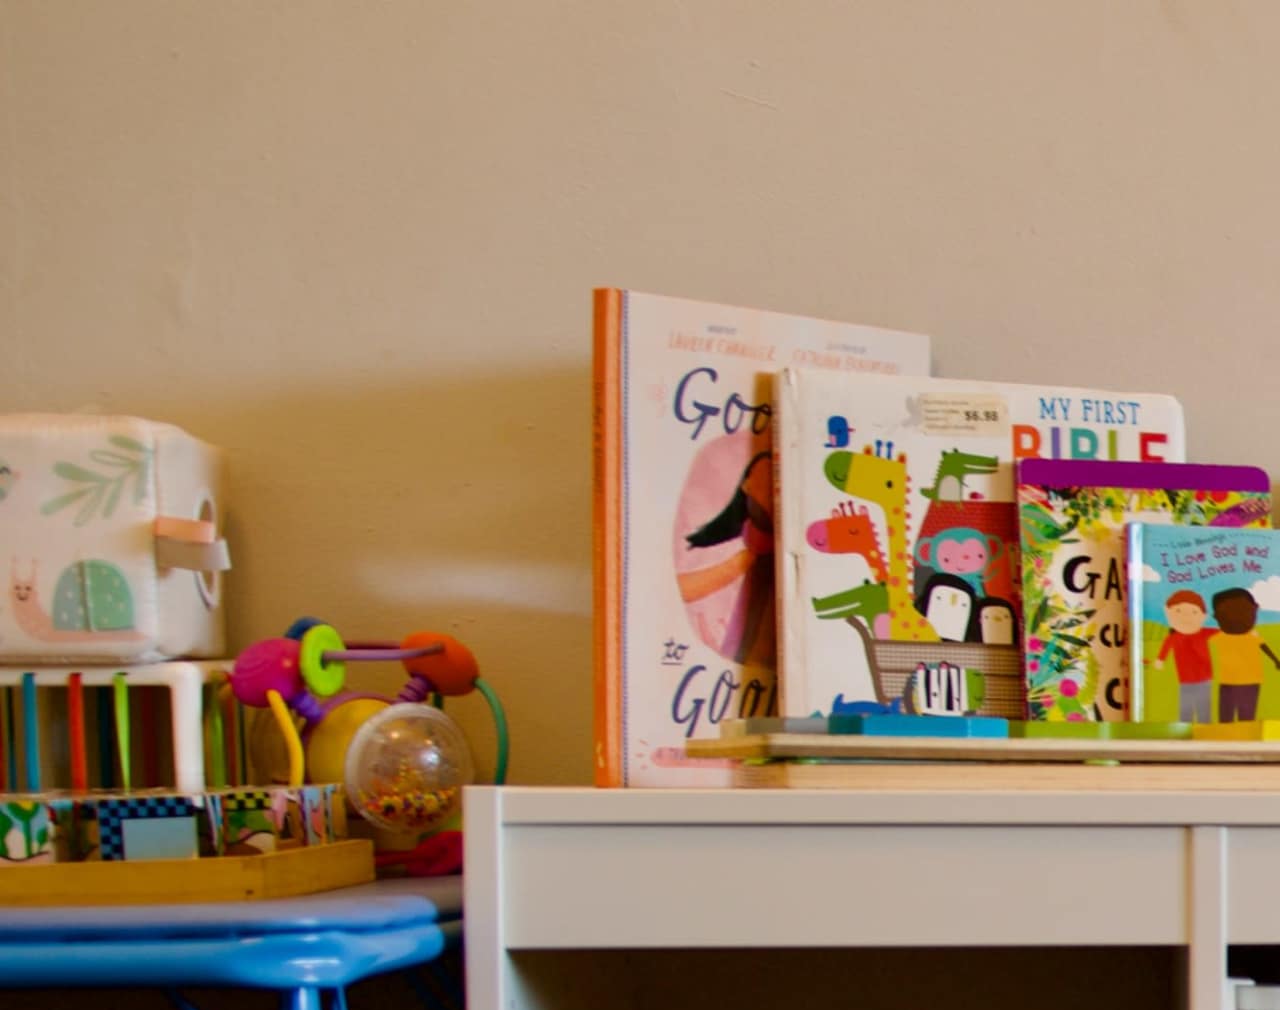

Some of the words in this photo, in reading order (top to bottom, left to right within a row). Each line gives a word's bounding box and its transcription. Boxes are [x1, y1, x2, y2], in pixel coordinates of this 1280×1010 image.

[1039, 398, 1071, 420] MY
[1082, 398, 1140, 425] FIRST
[1160, 552, 1169, 567] I
[1176, 552, 1206, 567] Love
[1211, 544, 1238, 559] God
[1244, 546, 1270, 559] and
[1168, 570, 1192, 583] God
[1198, 562, 1236, 579] Loves
[1243, 559, 1263, 573] Me
[662, 638, 689, 660] to
